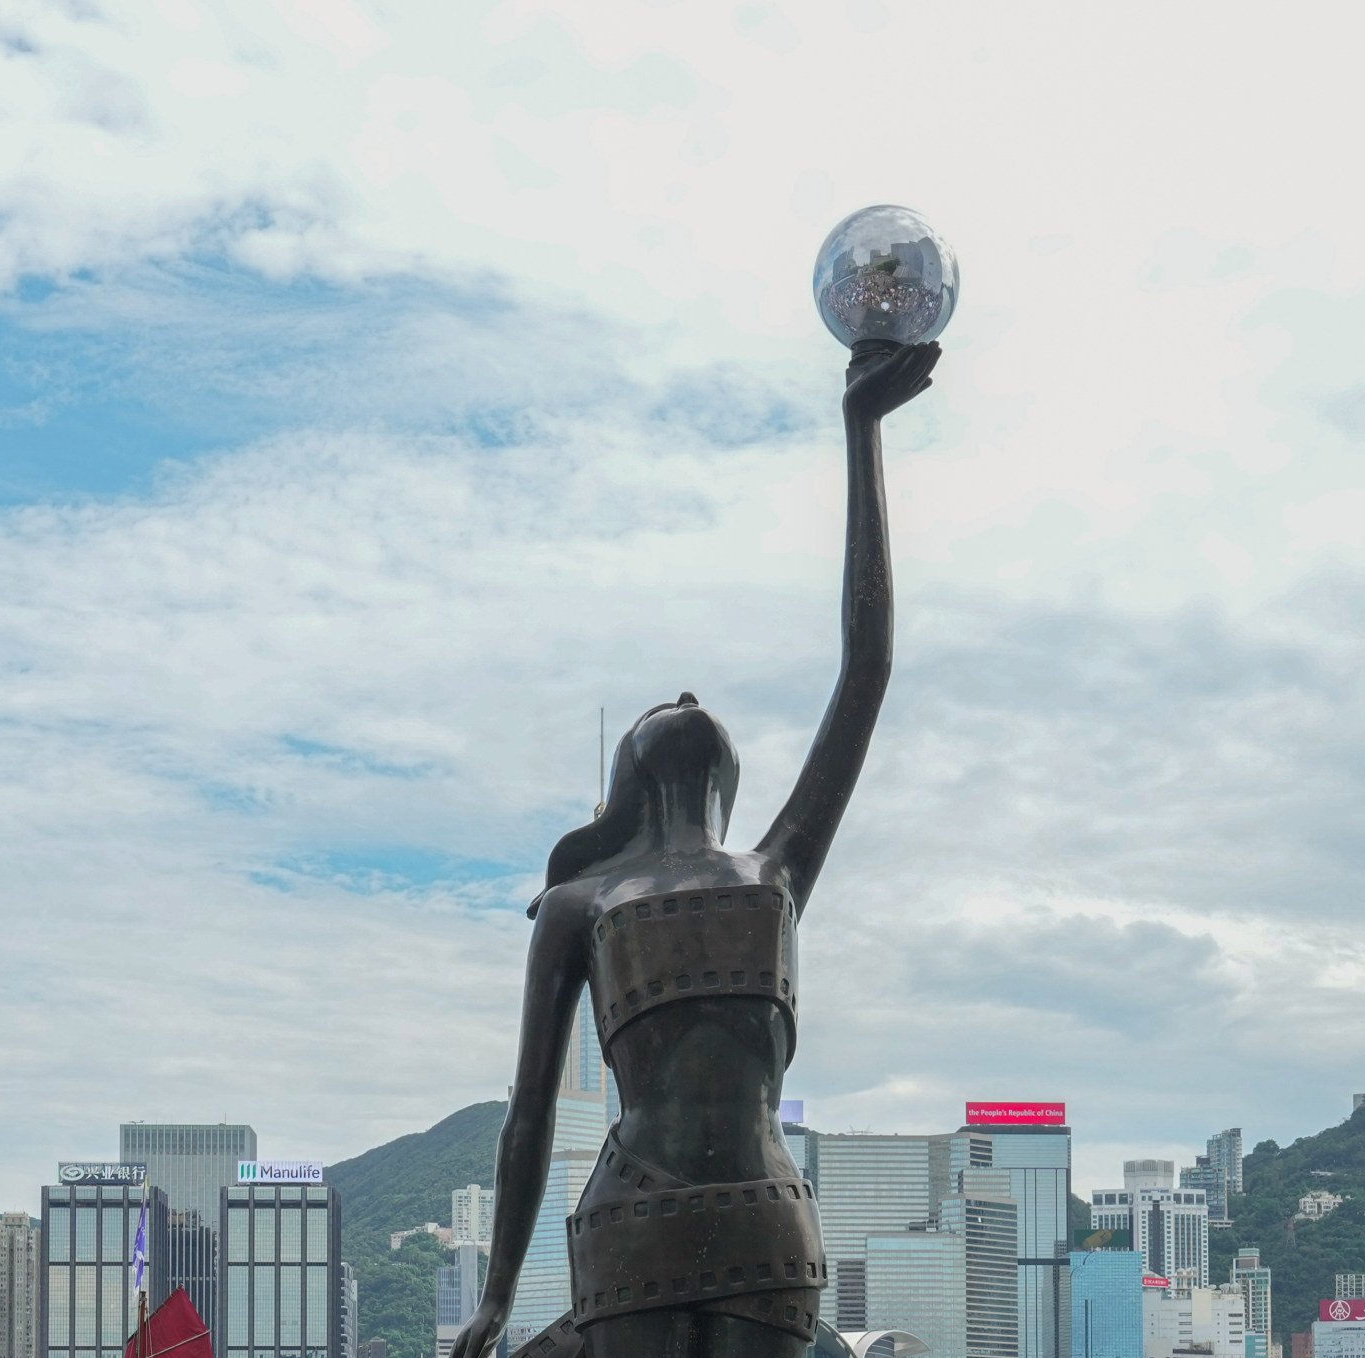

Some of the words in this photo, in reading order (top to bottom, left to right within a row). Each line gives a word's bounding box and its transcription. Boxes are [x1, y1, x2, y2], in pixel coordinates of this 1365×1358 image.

[981, 1109, 1007, 1117] People's
[1009, 1109, 1035, 1117] Republic
[84, 1165, 146, 1180] 兴业银行
[260, 1165, 320, 1179] Manulife
